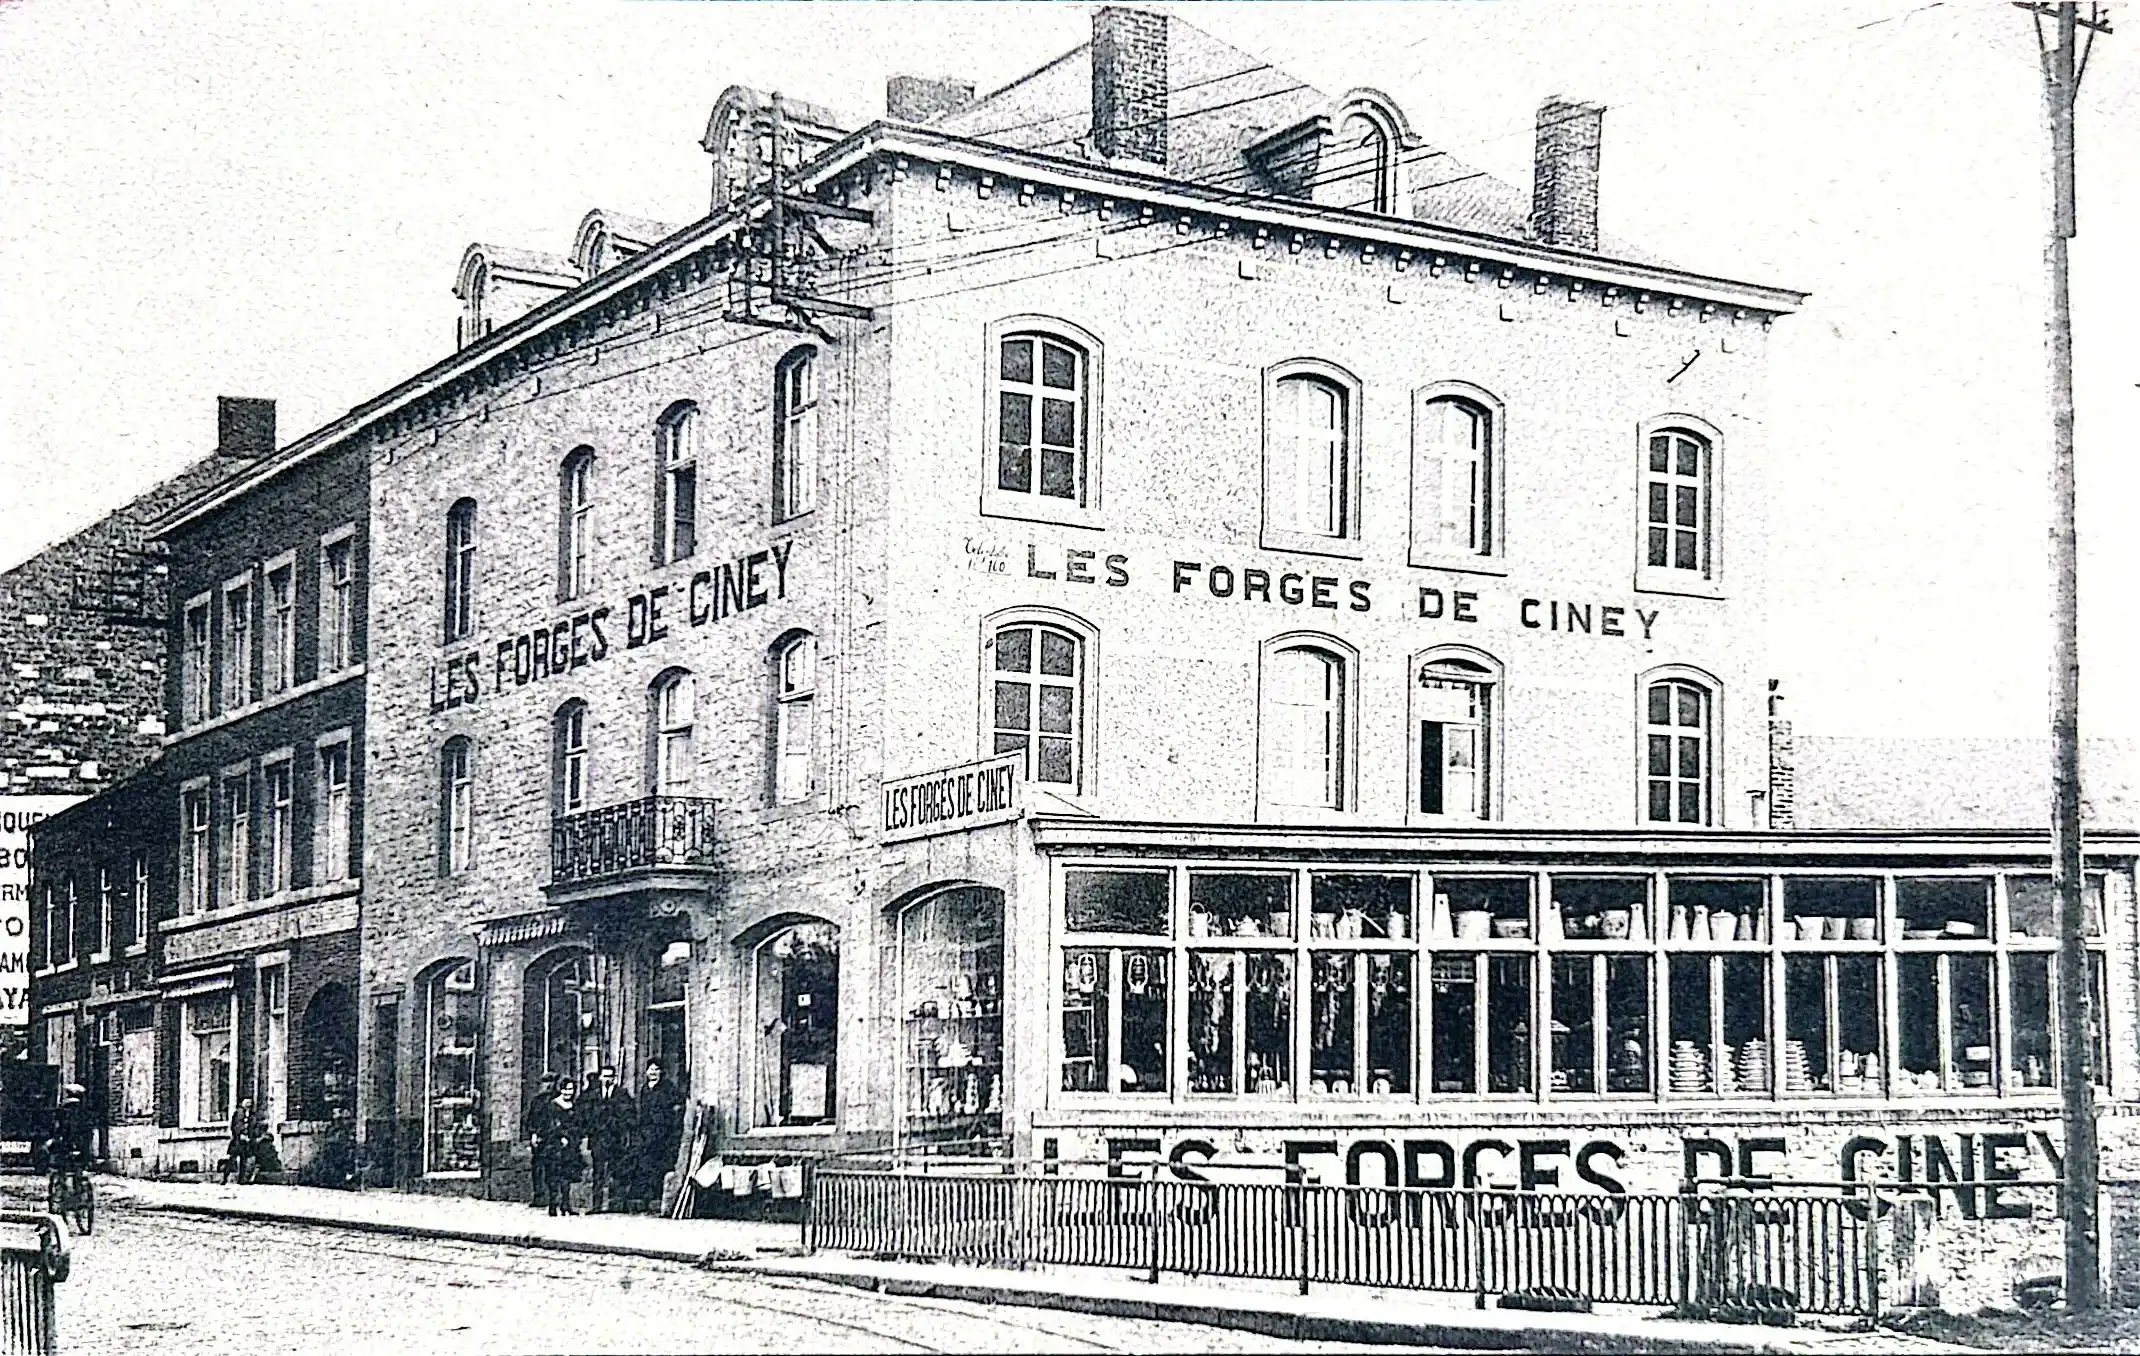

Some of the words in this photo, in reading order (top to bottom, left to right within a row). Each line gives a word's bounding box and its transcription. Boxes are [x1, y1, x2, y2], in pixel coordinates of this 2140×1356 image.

[429, 650, 481, 715] LES
[495, 607, 610, 693] FORGES
[626, 584, 669, 650] DE
[689, 539, 794, 628] CINEY
[1027, 543, 1130, 587] LES
[1172, 560, 1372, 613] FORGES
[1418, 586, 1478, 623] DE
[1520, 598, 1660, 639] CINEY
[885, 786, 908, 831] LES
[910, 776, 955, 827] FORGES
[957, 773, 974, 818] DE
[977, 764, 1015, 813] CINEY
[1043, 1137, 1220, 1226] LES
[1282, 1138, 1627, 1229] FORGES
[1682, 1136, 1790, 1226] DE
